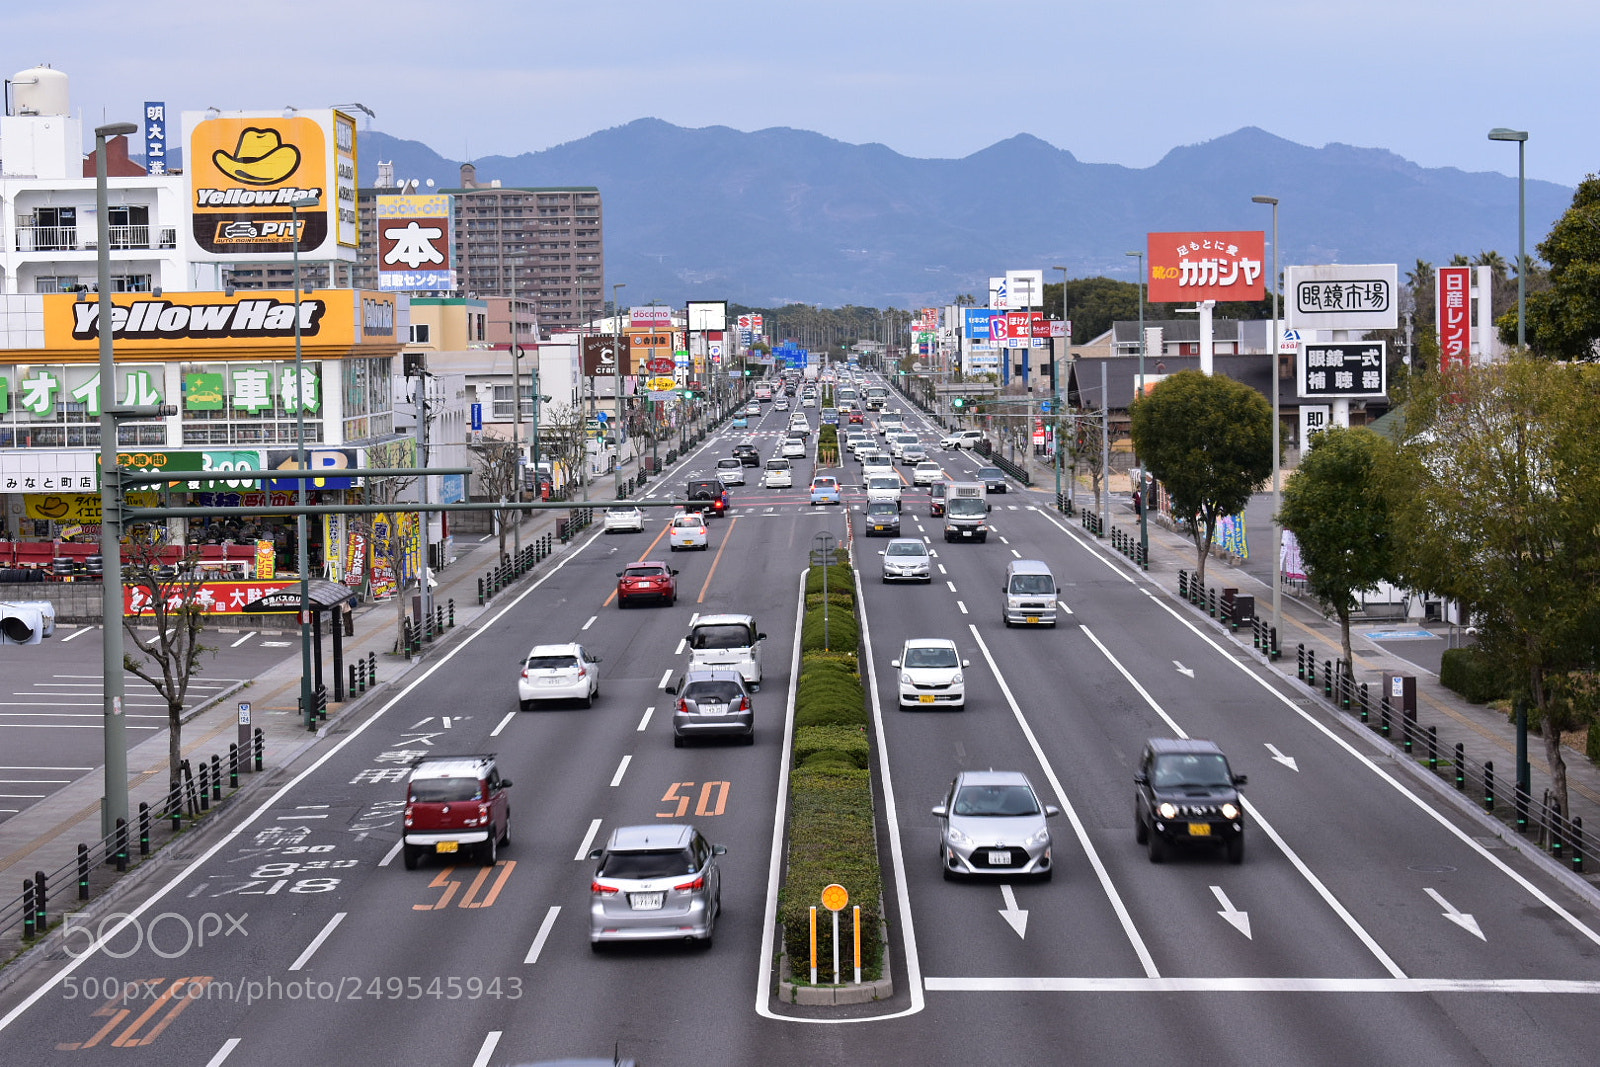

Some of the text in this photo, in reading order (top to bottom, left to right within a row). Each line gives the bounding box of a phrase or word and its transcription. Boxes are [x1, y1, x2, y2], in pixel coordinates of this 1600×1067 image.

[146, 106, 165, 175] 明大工業
[261, 222, 303, 236] PIT
[383, 221, 445, 269] 本
[1177, 239, 1239, 257] 足もとに愛
[380, 274, 450, 288] 買取センター
[1152, 257, 1261, 287] 靴の カガシヤ
[1302, 287, 1385, 310] 眼鏡市場
[633, 310, 668, 318] docomo
[1308, 350, 1379, 368] 眼鏡一式
[1308, 372, 1380, 389] 補聴器
[21, 368, 320, 416] オイル 車検
[99, 454, 167, 467] 業時間
[6, 477, 92, 488] みなと町店
[656, 781, 731, 818] 50
[412, 860, 517, 911] 50
